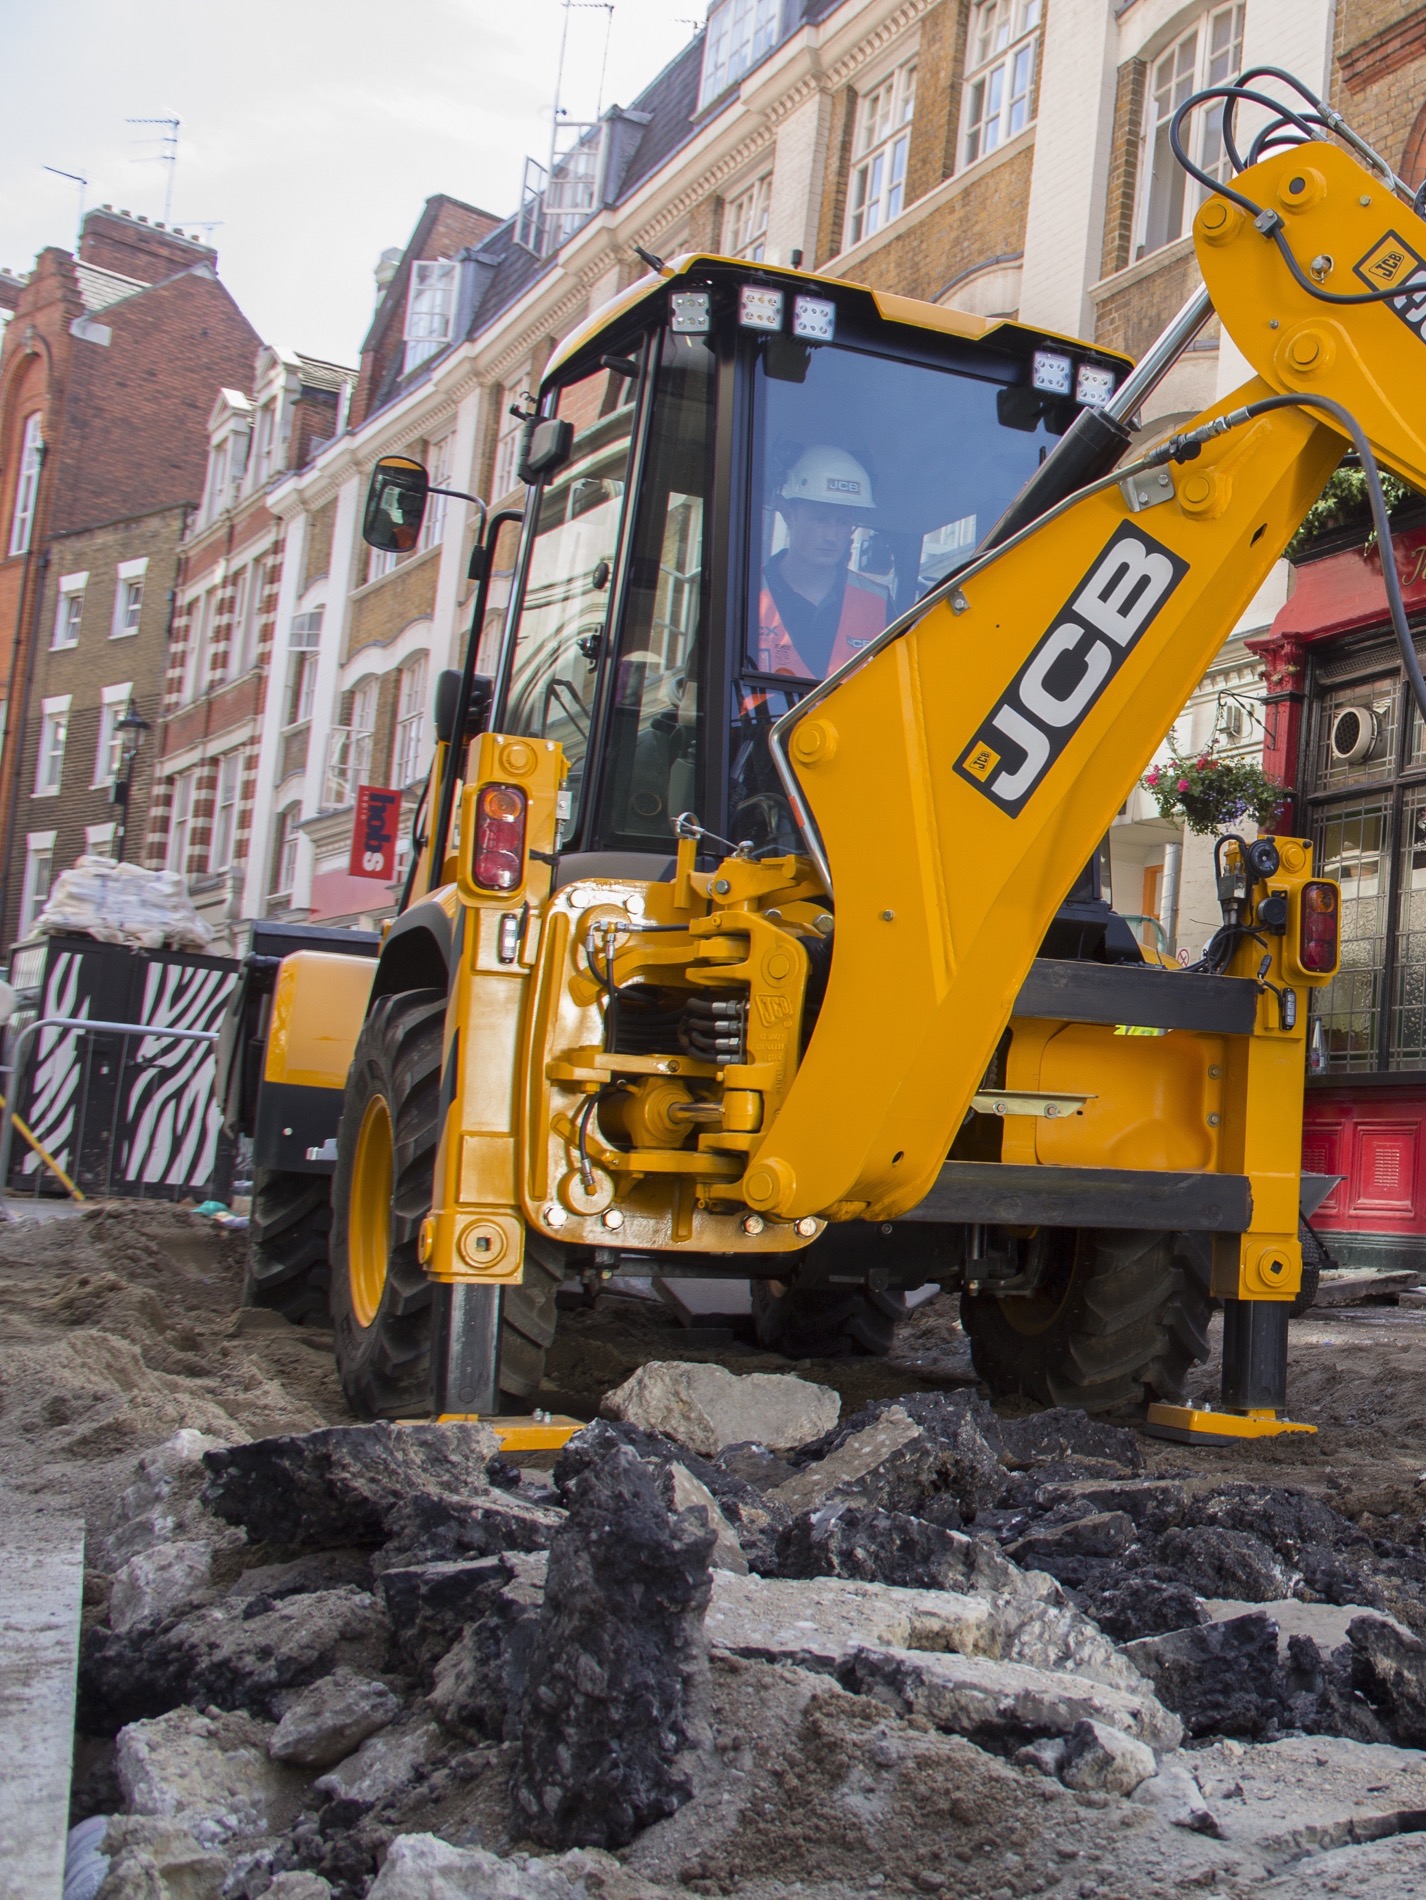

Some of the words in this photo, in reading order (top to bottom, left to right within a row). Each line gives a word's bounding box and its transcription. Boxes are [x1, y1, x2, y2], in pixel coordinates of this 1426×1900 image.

[1375, 253, 1402, 278] JCB
[829, 480, 859, 492] JCB
[991, 538, 1174, 801] JCB
[973, 751, 990, 770] JCB
[362, 791, 396, 872] hobs
